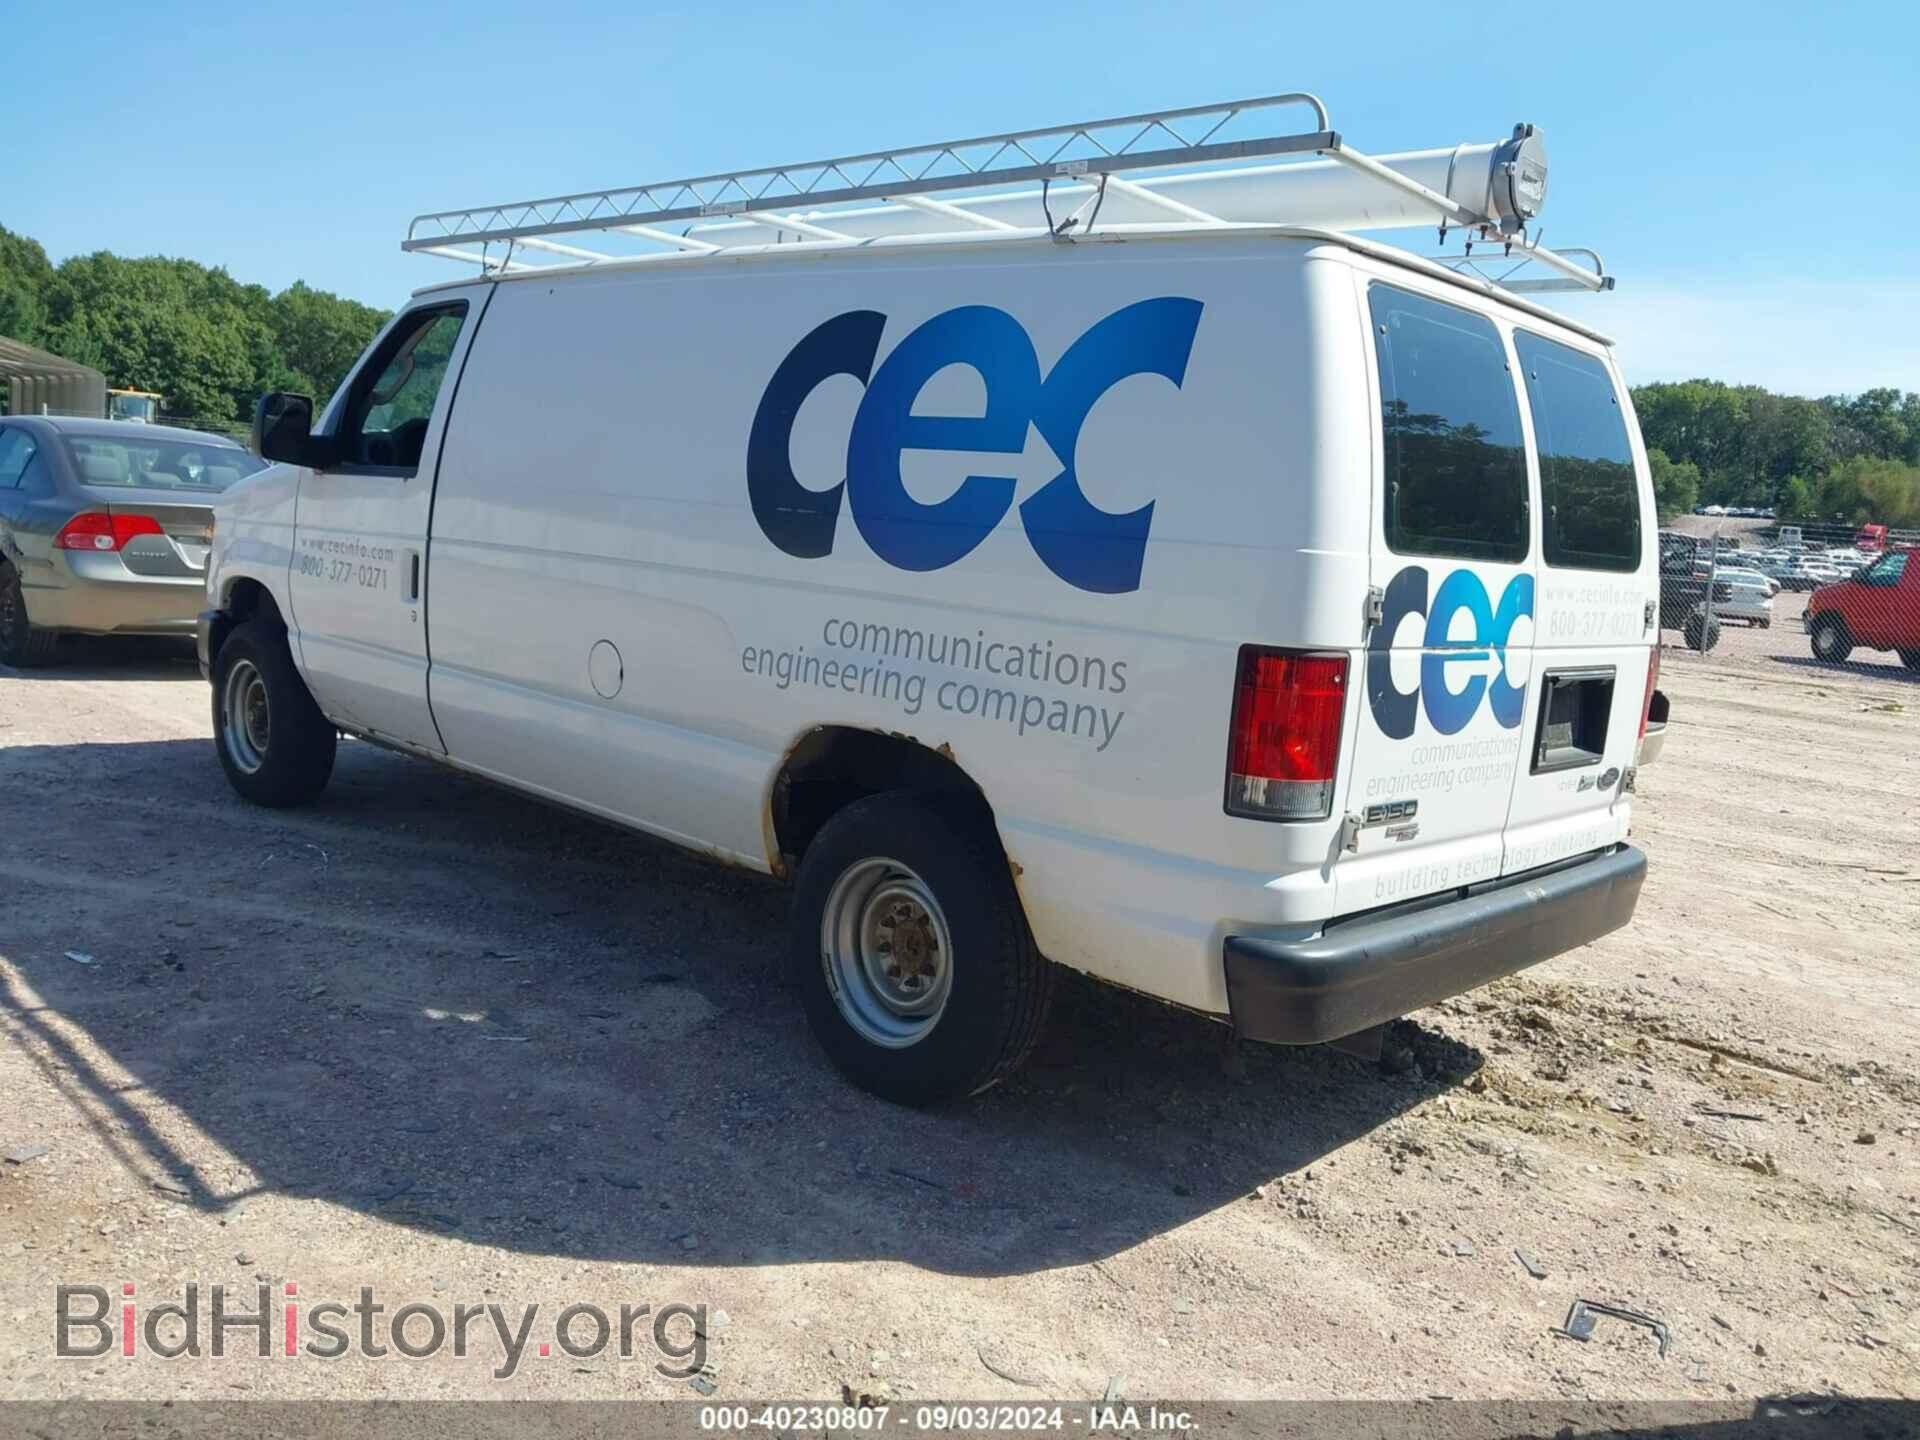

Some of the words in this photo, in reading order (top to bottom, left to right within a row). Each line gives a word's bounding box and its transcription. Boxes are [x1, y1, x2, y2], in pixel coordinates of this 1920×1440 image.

[301, 554, 388, 590] 800-377-0271
[822, 617, 1128, 694] communications
[741, 643, 926, 715] engineering
[937, 679, 1126, 753] company
[1411, 736, 1519, 764] communications
[1366, 763, 1455, 796] engineering
[1375, 863, 1449, 899] building
